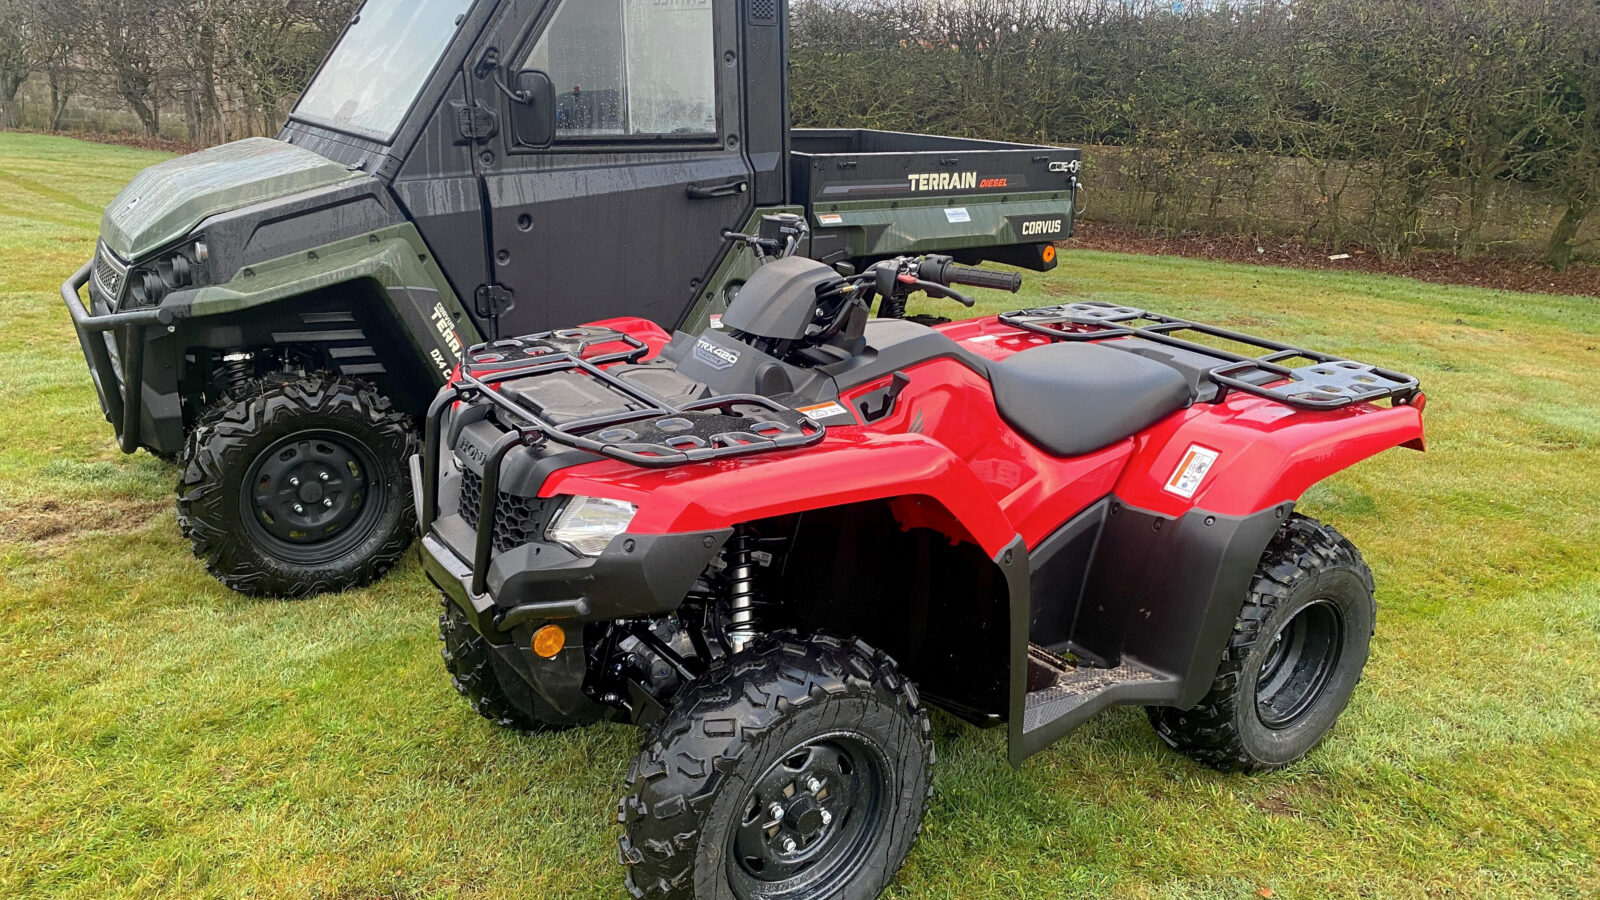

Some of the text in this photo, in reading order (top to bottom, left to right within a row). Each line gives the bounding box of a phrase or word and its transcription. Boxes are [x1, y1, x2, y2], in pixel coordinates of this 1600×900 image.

[908, 172, 1008, 191] TERRAIN DIESEL
[1022, 220, 1062, 235] CORVUS
[436, 301, 455, 330] CORVUS
[430, 348, 453, 380] DX4 C
[697, 339, 738, 364] TRX420
